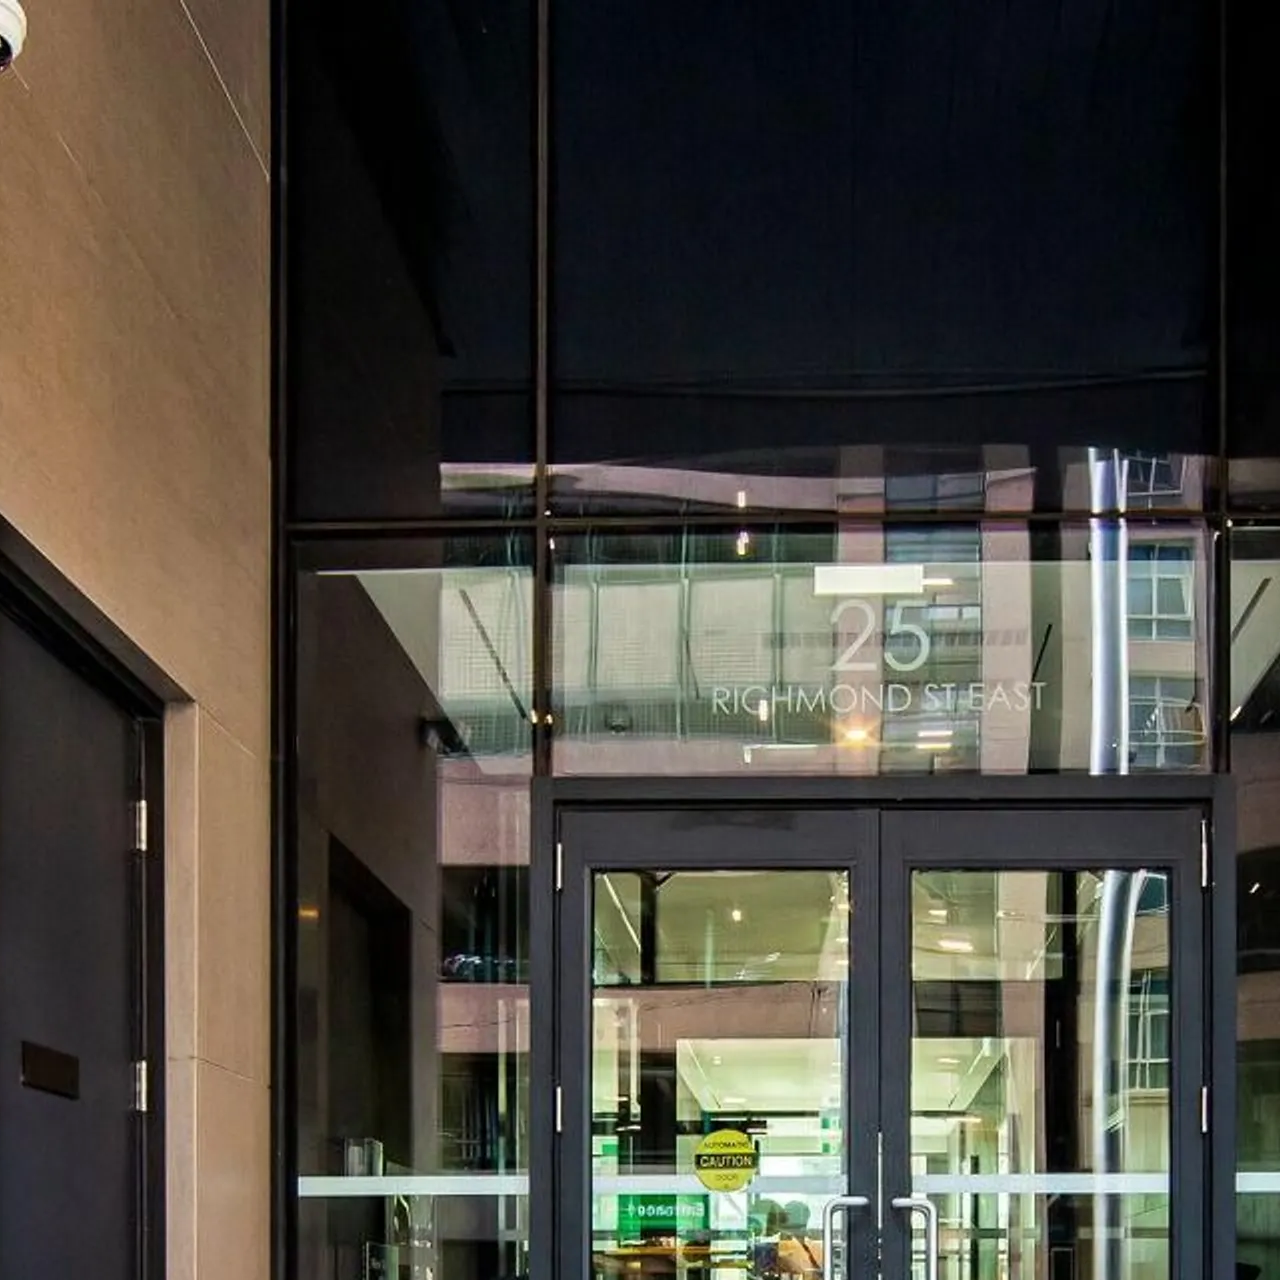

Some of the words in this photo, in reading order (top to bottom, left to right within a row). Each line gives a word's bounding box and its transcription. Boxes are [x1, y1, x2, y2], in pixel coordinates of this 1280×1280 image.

[829, 598, 931, 672] 25
[711, 683, 912, 716] RICHMOND
[923, 682, 958, 712] ST
[968, 681, 1048, 711] EAST
[699, 1155, 753, 1168] CAUTION
